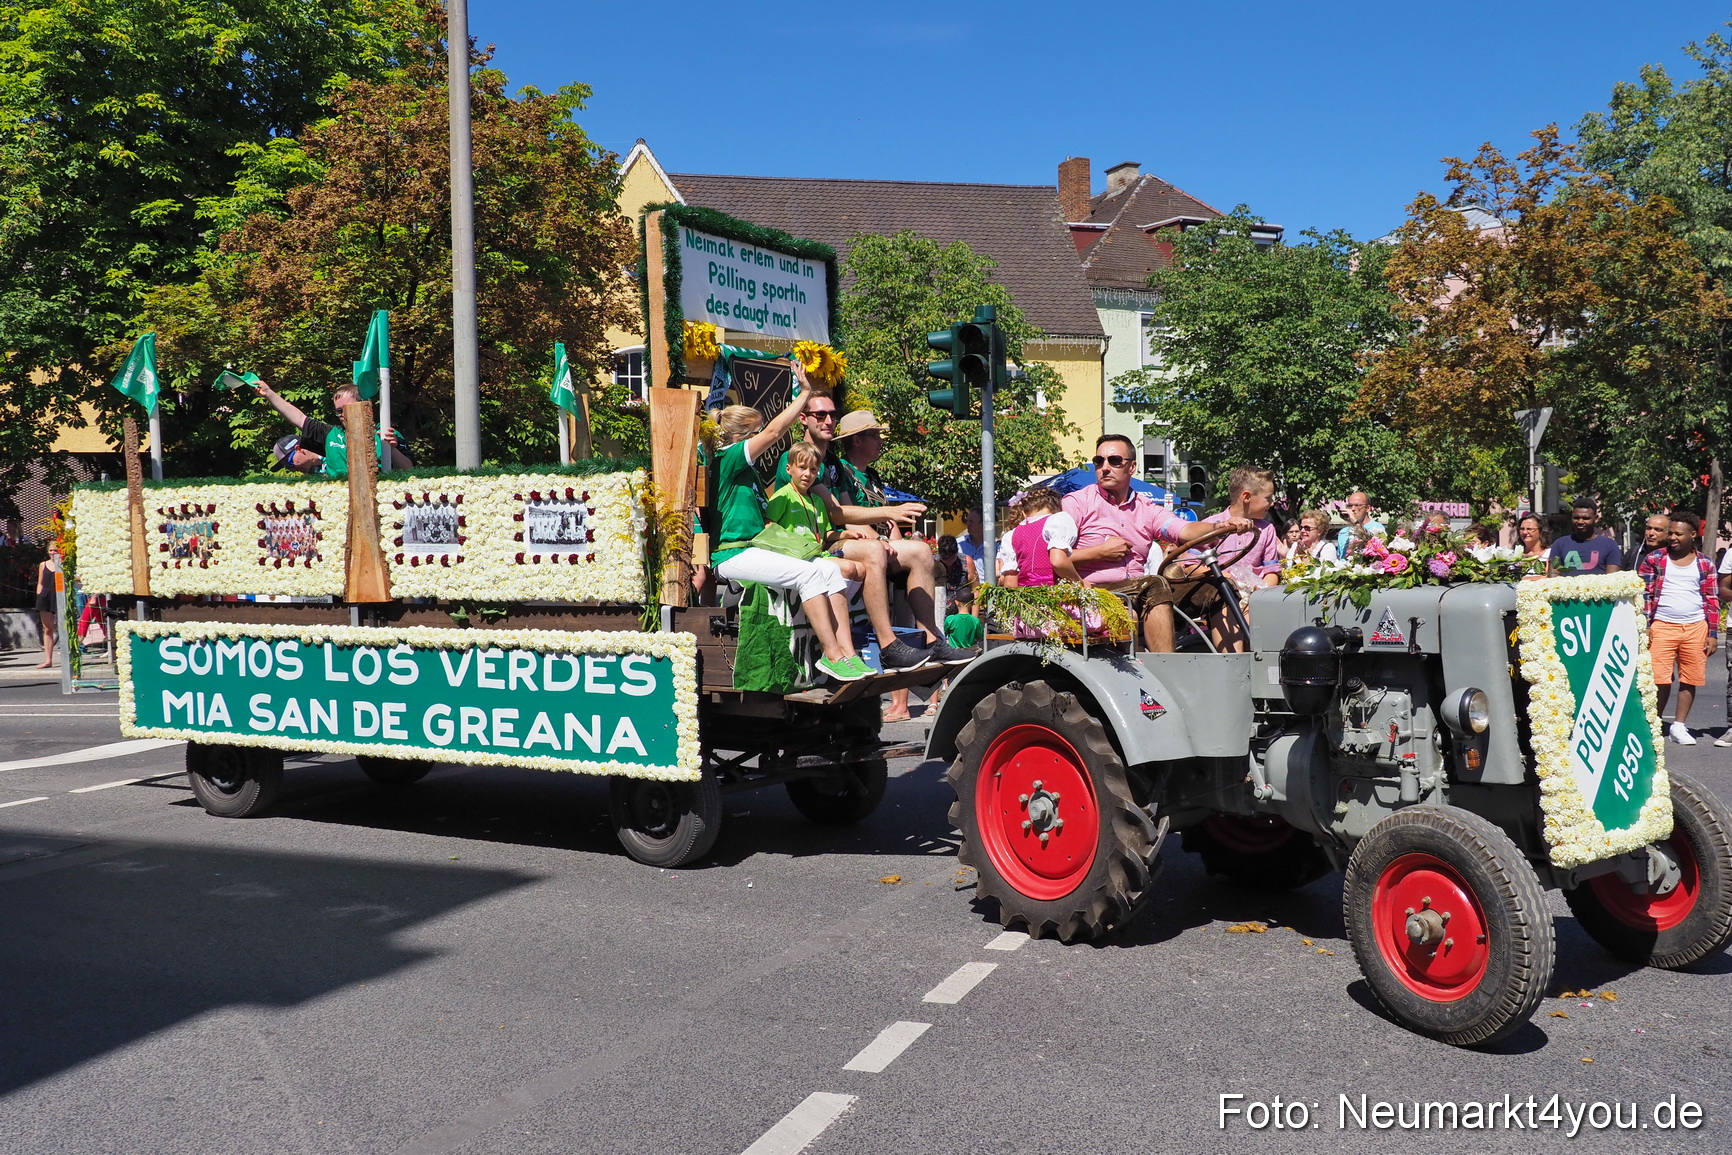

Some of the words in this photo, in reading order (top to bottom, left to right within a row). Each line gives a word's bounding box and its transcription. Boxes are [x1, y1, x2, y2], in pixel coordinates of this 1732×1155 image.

[708, 261, 756, 300] Pölling
[740, 246, 775, 269] erlem
[780, 257, 800, 275] und
[802, 260, 814, 278] in
[705, 293, 730, 316] des
[732, 298, 769, 330] daugt
[744, 370, 760, 391] SV
[759, 437, 786, 472] 1950
[1560, 613, 1592, 657] SV
[158, 638, 303, 681] SOMOS
[324, 644, 420, 687] LOS
[437, 648, 658, 697] VERDES
[161, 689, 234, 729] MIA
[249, 693, 341, 737] SAN
[353, 700, 409, 741] DE
[422, 703, 649, 757] GREANA
[1575, 633, 1631, 774] PÖLLING
[1613, 732, 1644, 802] 1950
